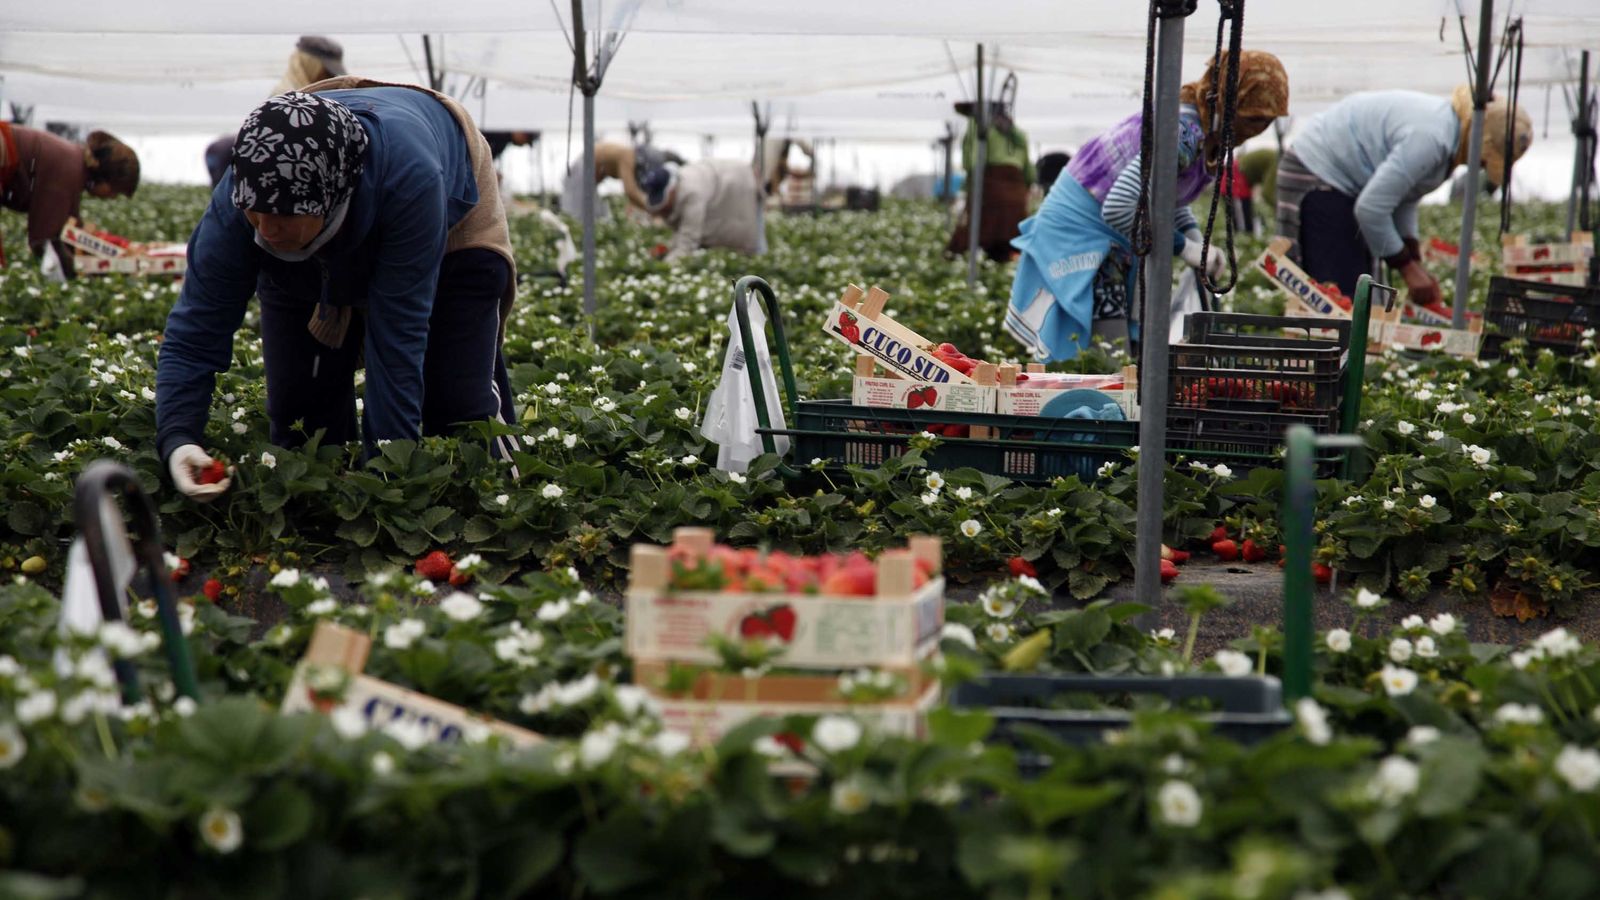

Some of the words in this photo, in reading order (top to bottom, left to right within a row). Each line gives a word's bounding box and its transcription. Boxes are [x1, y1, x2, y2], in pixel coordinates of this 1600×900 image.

[1279, 267, 1309, 296] CUCO
[1309, 292, 1332, 314] SUD
[863, 327, 912, 365] CUCO
[911, 356, 950, 383] SUD
